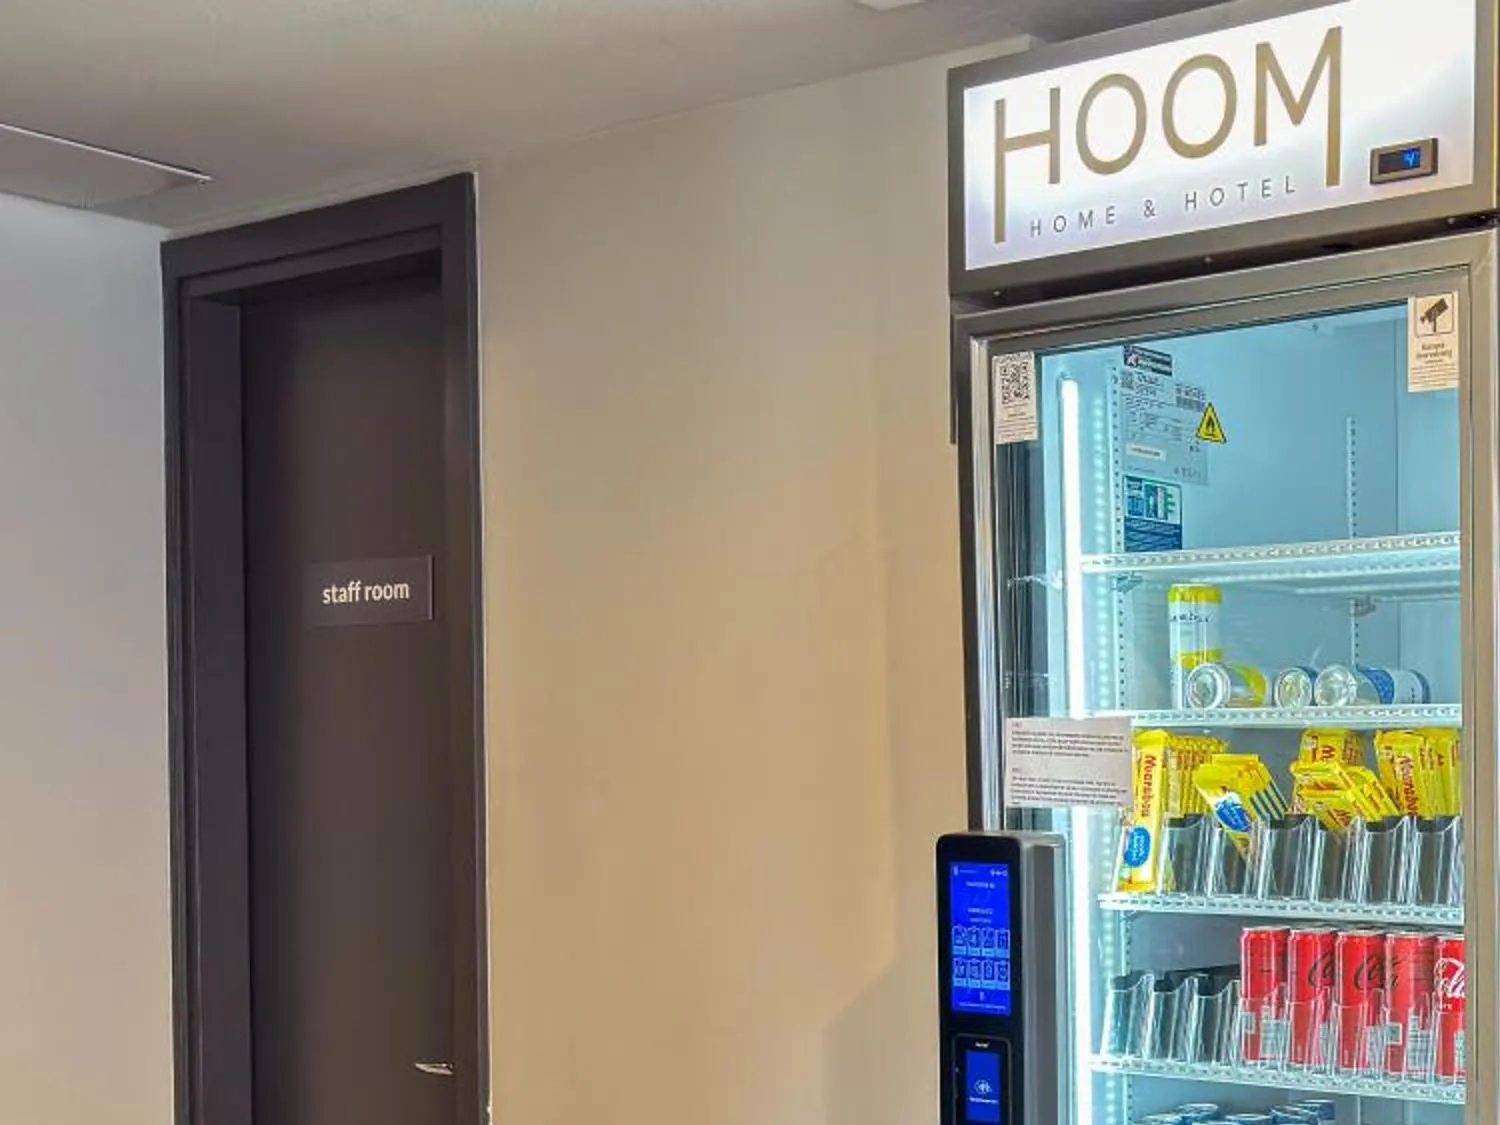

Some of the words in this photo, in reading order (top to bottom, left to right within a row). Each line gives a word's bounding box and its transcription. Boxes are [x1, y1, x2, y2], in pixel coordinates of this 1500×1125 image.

[993, 26, 1342, 245] HOOM
[1030, 205, 1117, 239] HOME
[1143, 199, 1157, 219] &
[1184, 175, 1297, 211] HOTEL
[322, 580, 362, 605] staff
[364, 582, 410, 602] room
